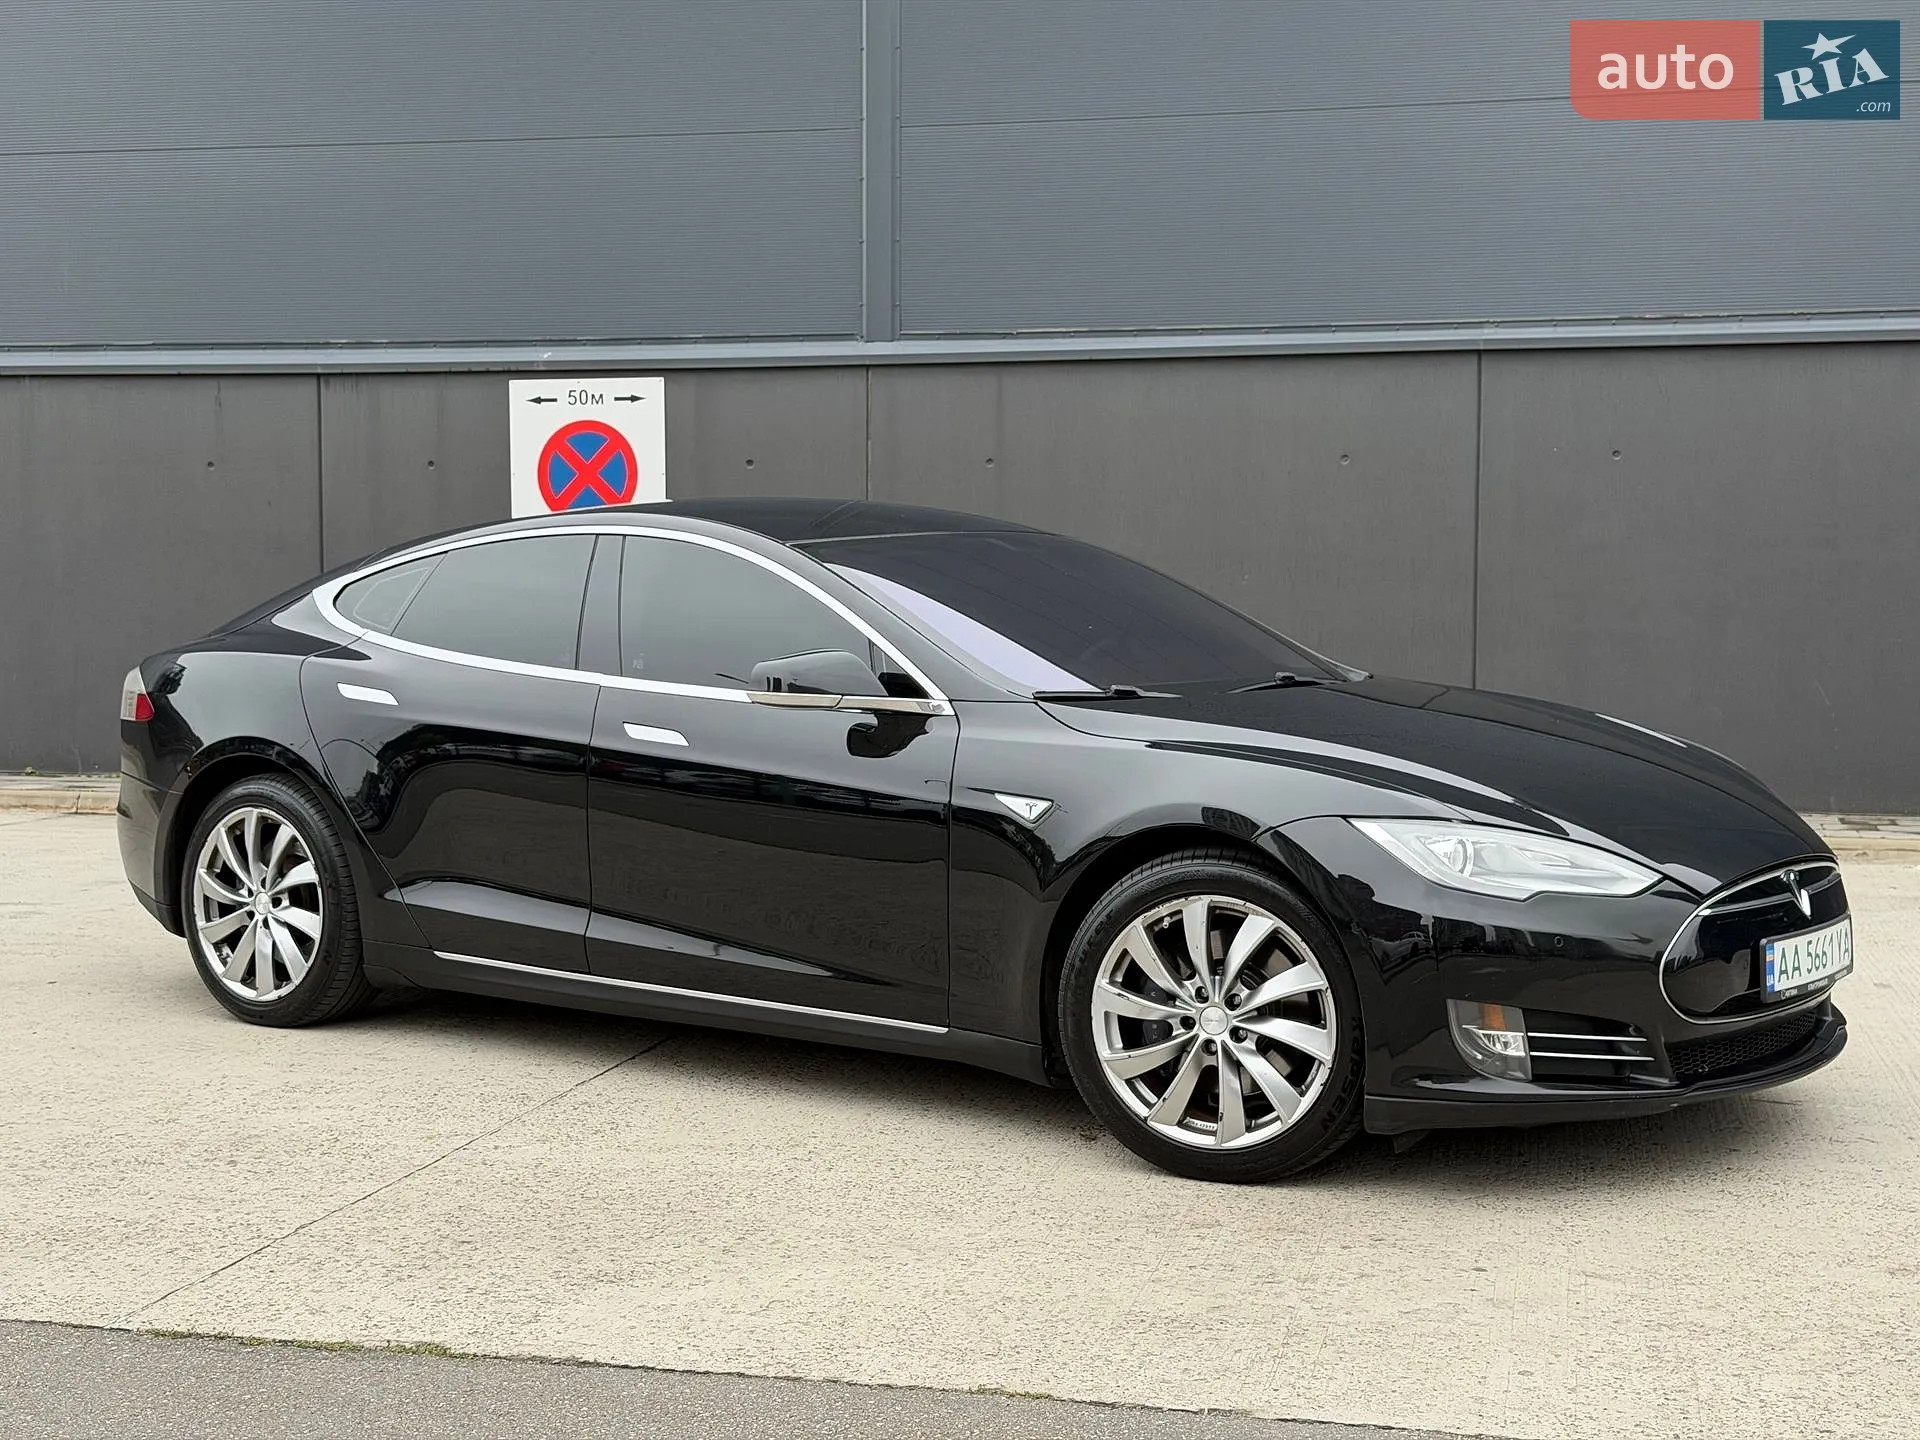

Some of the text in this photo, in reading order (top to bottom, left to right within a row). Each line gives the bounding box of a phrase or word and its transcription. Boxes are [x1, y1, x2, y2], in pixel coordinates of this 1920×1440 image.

[567, 390, 604, 406] 50м
[1778, 944, 1801, 983] AA
[1806, 933, 1834, 974] 5661
